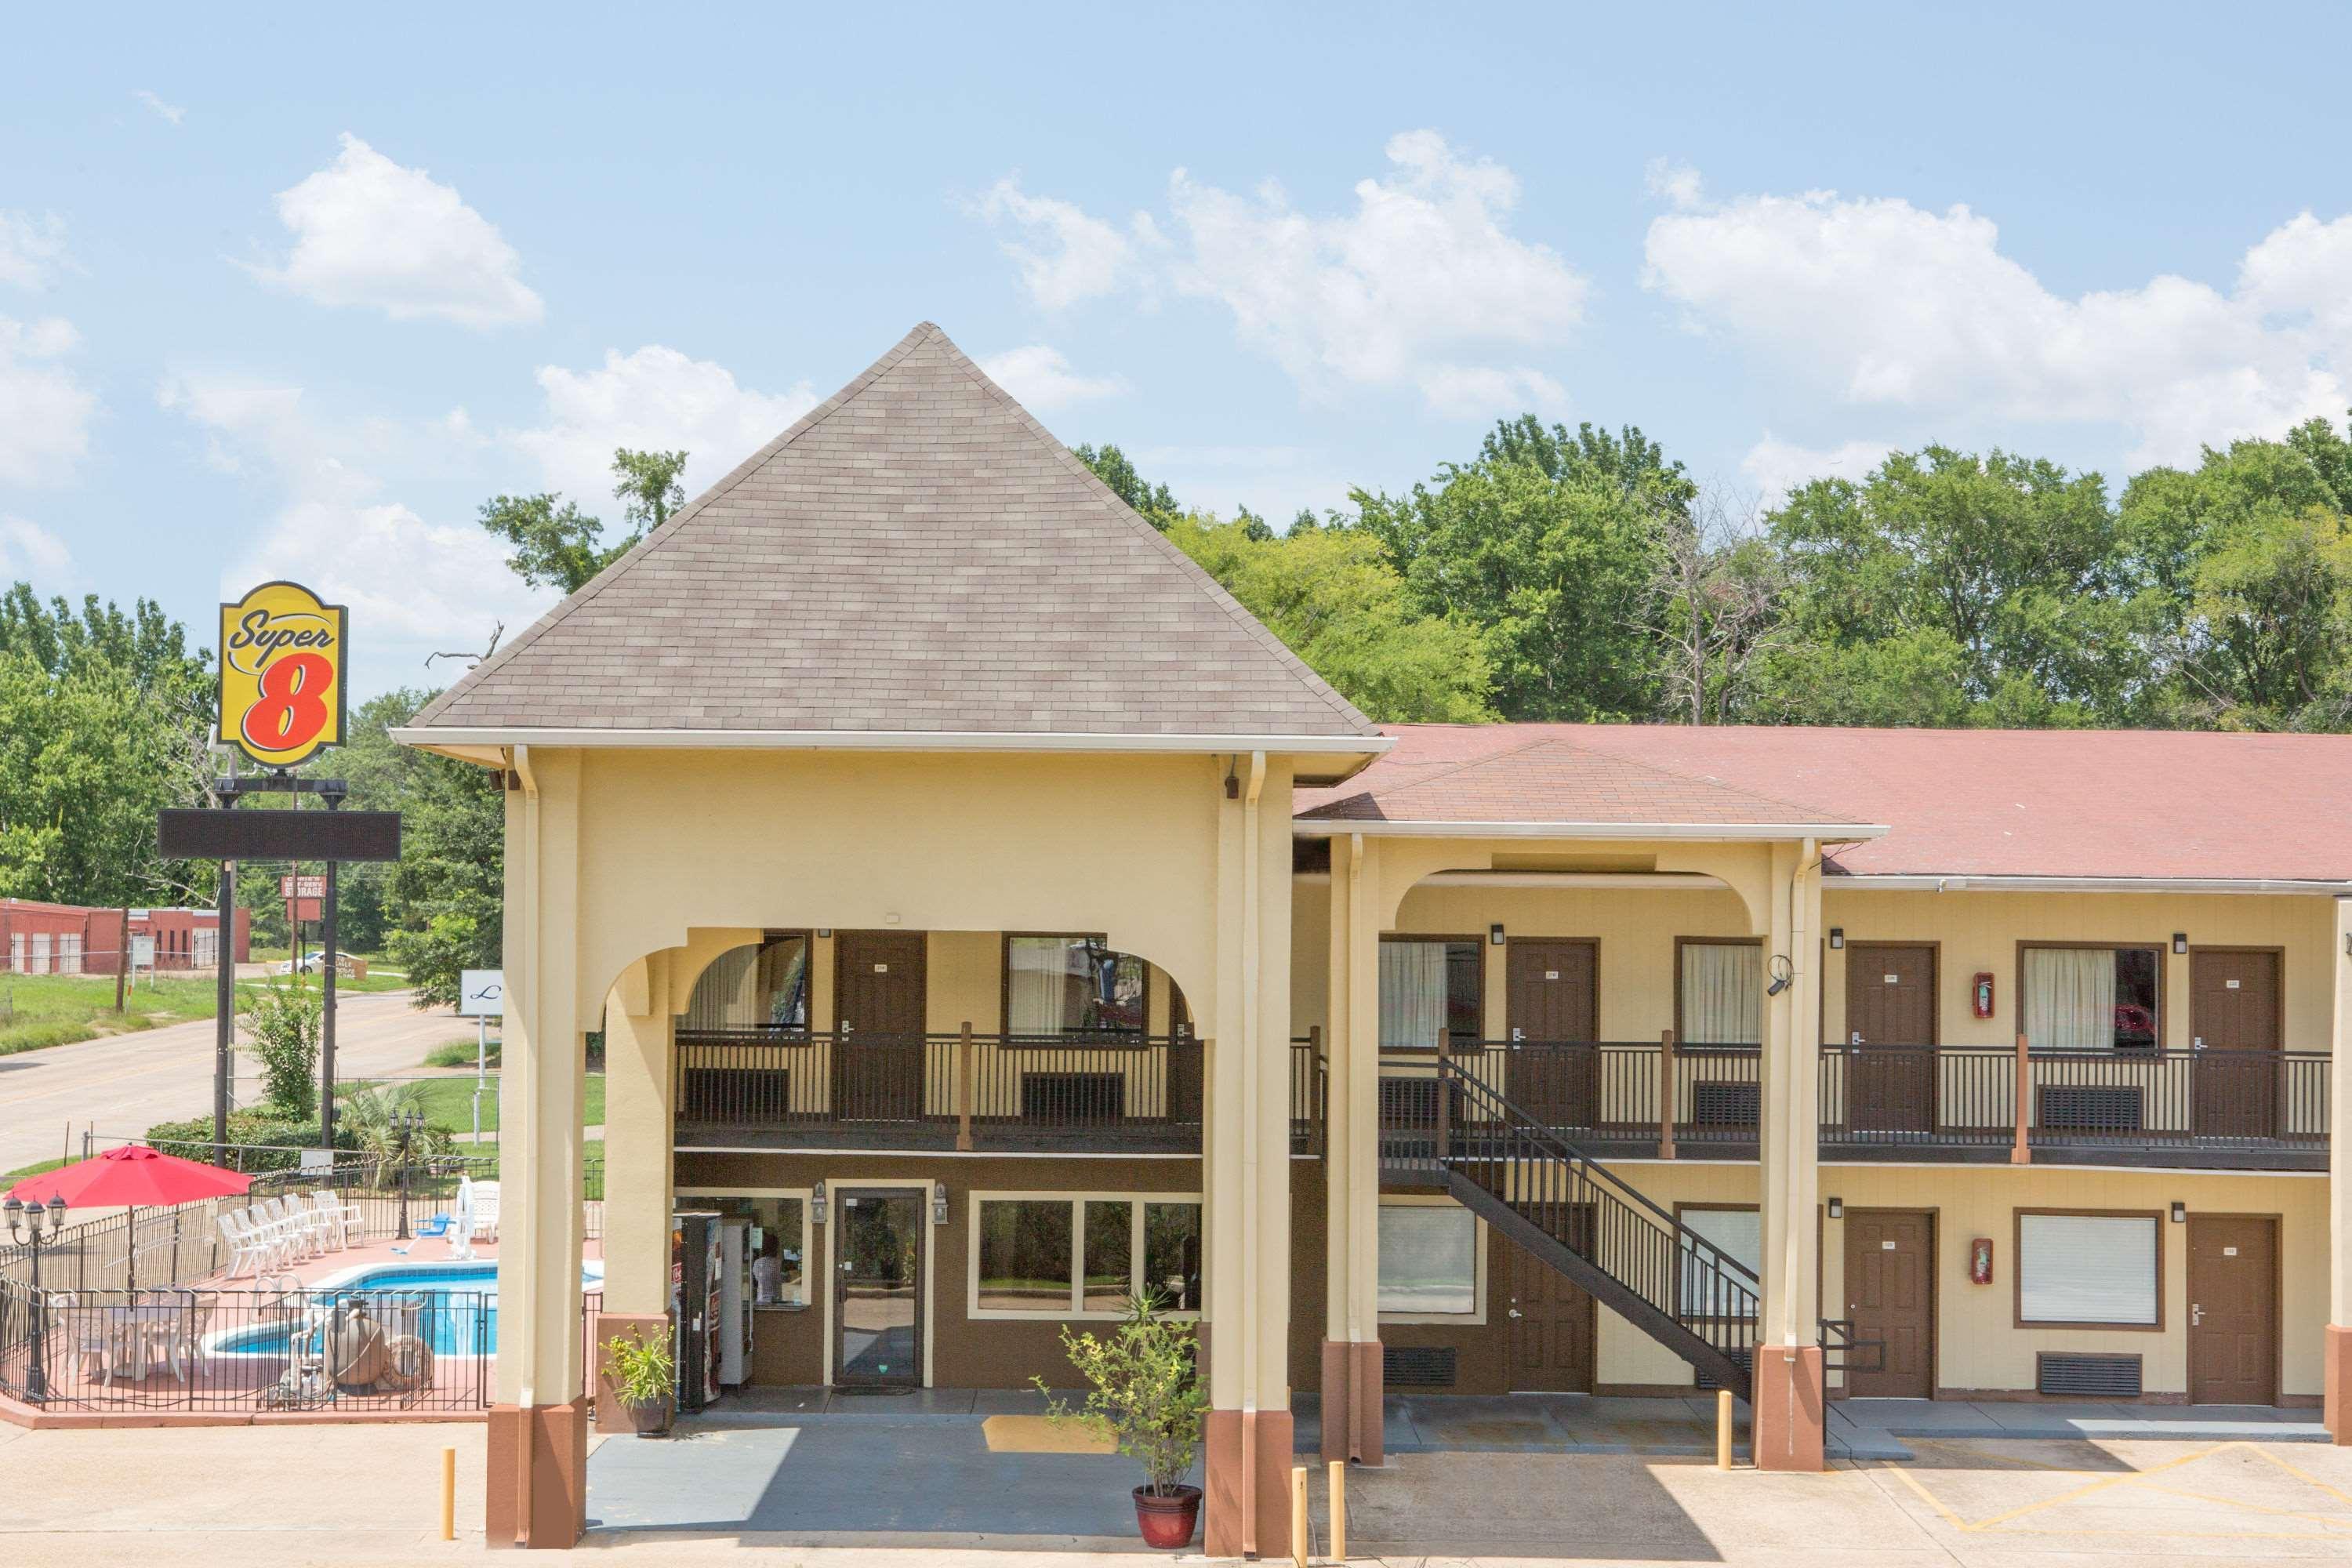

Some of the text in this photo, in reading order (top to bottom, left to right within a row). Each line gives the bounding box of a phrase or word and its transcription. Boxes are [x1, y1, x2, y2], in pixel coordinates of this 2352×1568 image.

[228, 608, 335, 668] Super
[240, 652, 334, 753] 8
[285, 887, 323, 897] STORAGE
